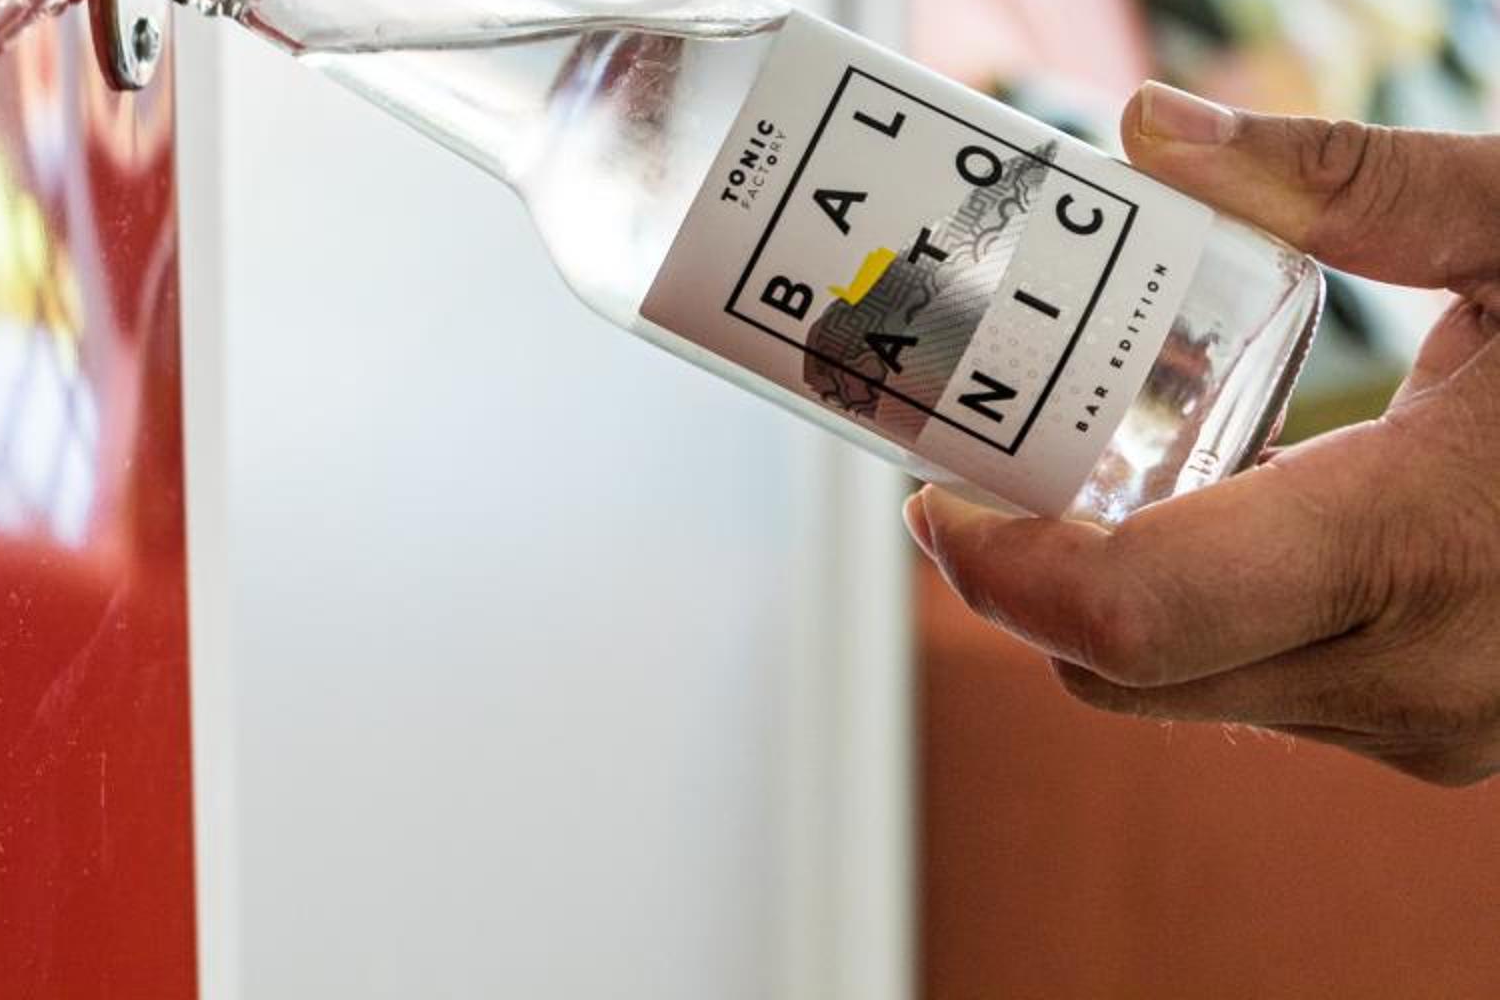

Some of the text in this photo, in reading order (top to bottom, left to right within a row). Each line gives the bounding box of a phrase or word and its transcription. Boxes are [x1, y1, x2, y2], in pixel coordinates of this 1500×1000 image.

[721, 119, 774, 202] TONIC
[740, 129, 787, 210] FACTORY
[1075, 263, 1168, 433] BAR EDITION
